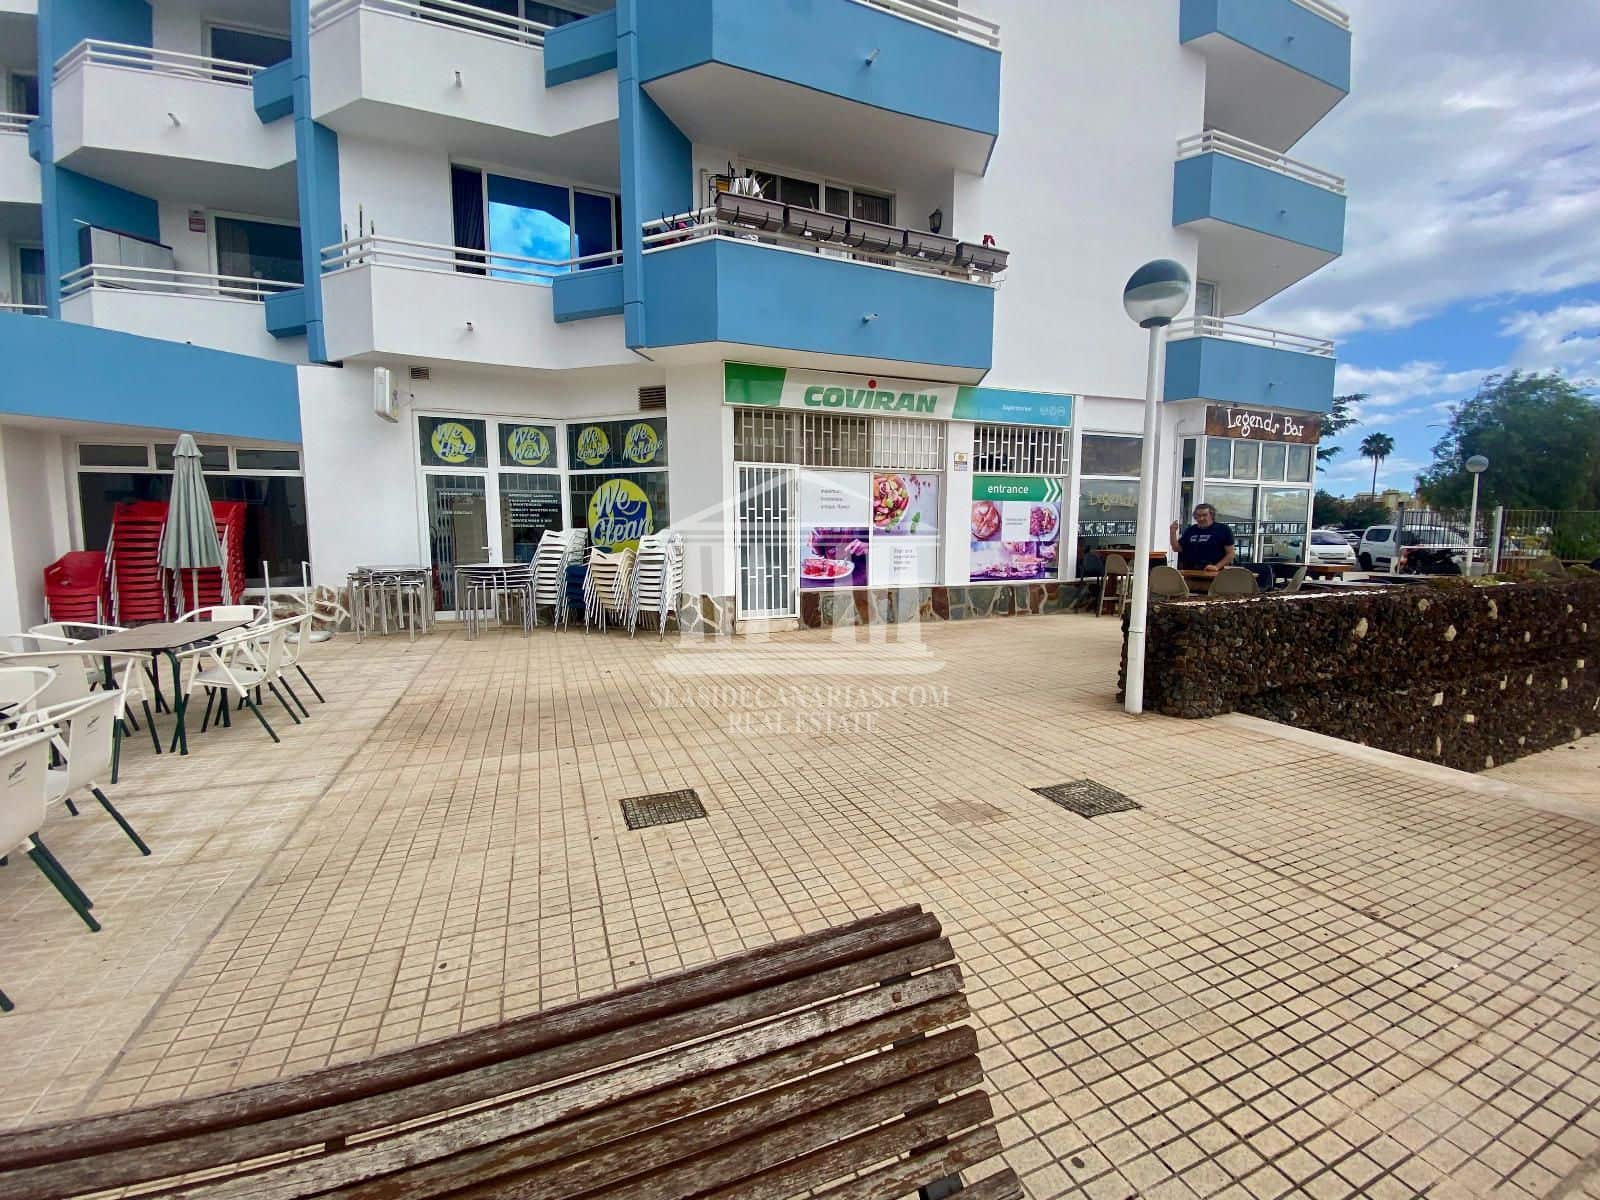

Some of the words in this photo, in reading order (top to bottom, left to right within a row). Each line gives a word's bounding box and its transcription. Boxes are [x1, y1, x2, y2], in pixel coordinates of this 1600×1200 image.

[803, 380, 938, 414] COVIRAN
[437, 424, 463, 441] We
[630, 425, 648, 443] We
[1226, 409, 1280, 437] Legends
[1283, 416, 1304, 437] Bar
[513, 428, 539, 445] We
[596, 480, 631, 517] We
[987, 483, 1029, 494] entrance
[591, 516, 654, 546] Clean
